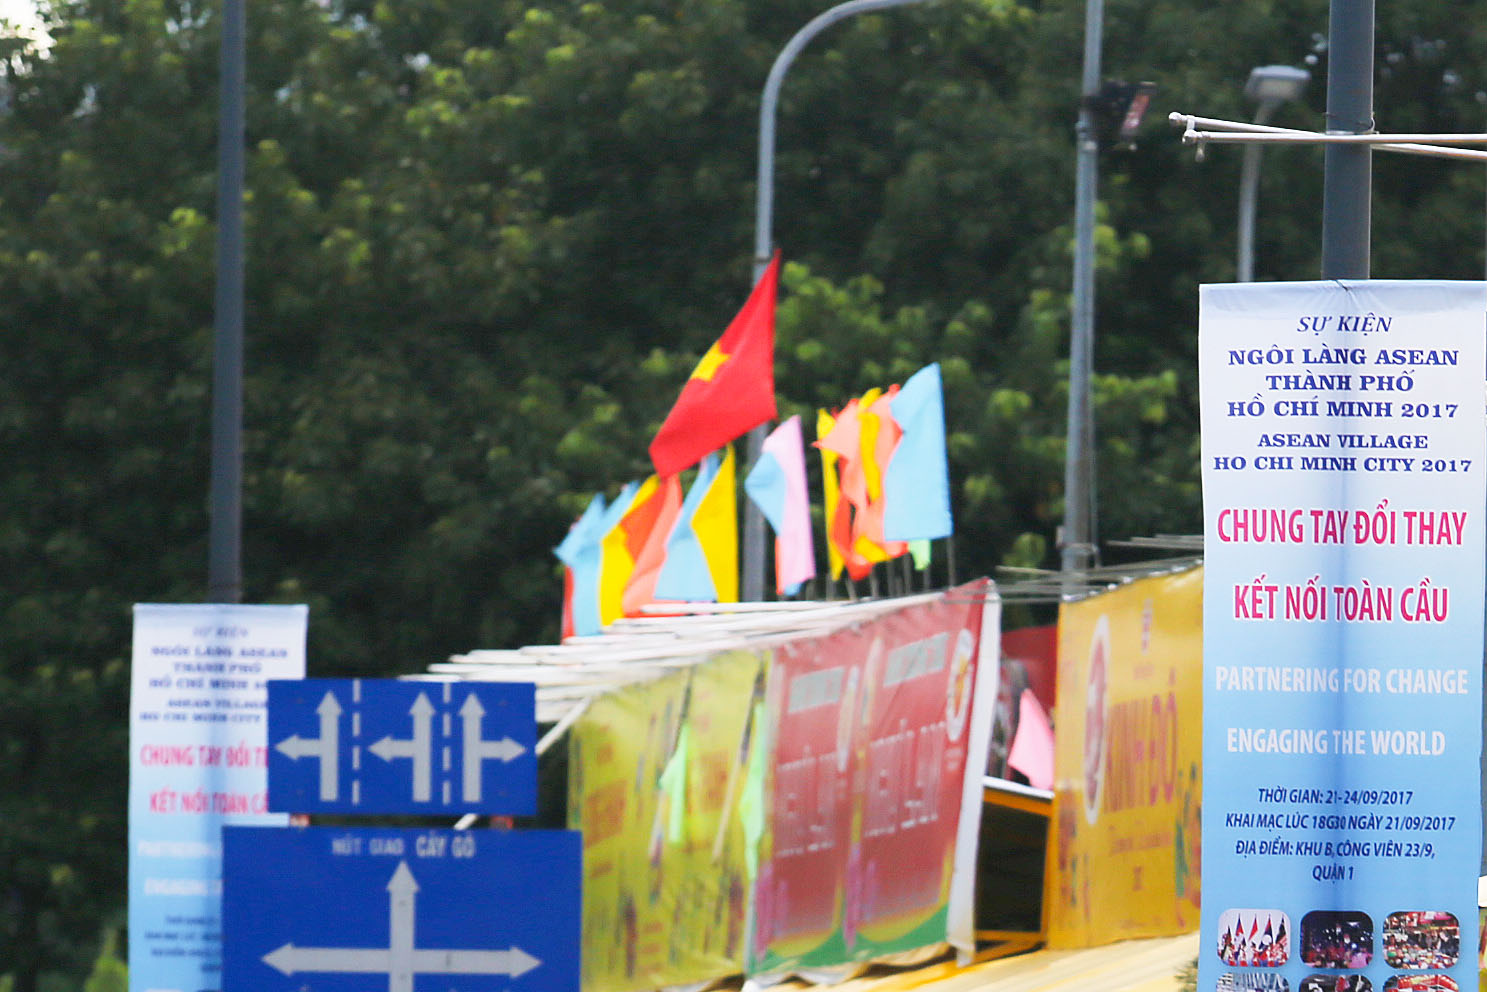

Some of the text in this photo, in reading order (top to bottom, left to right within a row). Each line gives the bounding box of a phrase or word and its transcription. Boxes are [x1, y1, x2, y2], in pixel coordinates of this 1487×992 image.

[1297, 312, 1393, 336] SỰ KIỆN
[1228, 343, 1460, 366] NGÔI LÀNG ASEAN
[1265, 369, 1415, 392] THÀNH PHỐ
[1227, 393, 1458, 418] HỒ CHÍ MINH 2017
[1257, 433, 1429, 449] ASEAN VILLAGE
[1213, 456, 1473, 473] HO CHI MINH CITY 2017
[1217, 498, 1468, 546] CHUNG TAY ĐỔI THAY
[1234, 573, 1449, 622] KẾT NỐI TOÀN CẦU
[1215, 665, 1469, 696] PARTNERING FOR CHANGE
[1227, 727, 1446, 756] ENGAGING THE WORLD
[1258, 786, 1285, 803] THỜI
[1288, 789, 1323, 804] GIAN:
[1225, 811, 1456, 832] KHAI MẠC LÚC 18G30 NGÀY 21/09/2017
[1235, 840, 1257, 859] ĐỊA
[1259, 838, 1293, 857] ĐIỂM:
[1295, 841, 1322, 856] KHU
[1336, 839, 1371, 857] CÔNG
[1373, 839, 1402, 857] VIÊN
[1405, 842, 1436, 860] 23/9,
[1312, 863, 1354, 883] QUẬN 1
